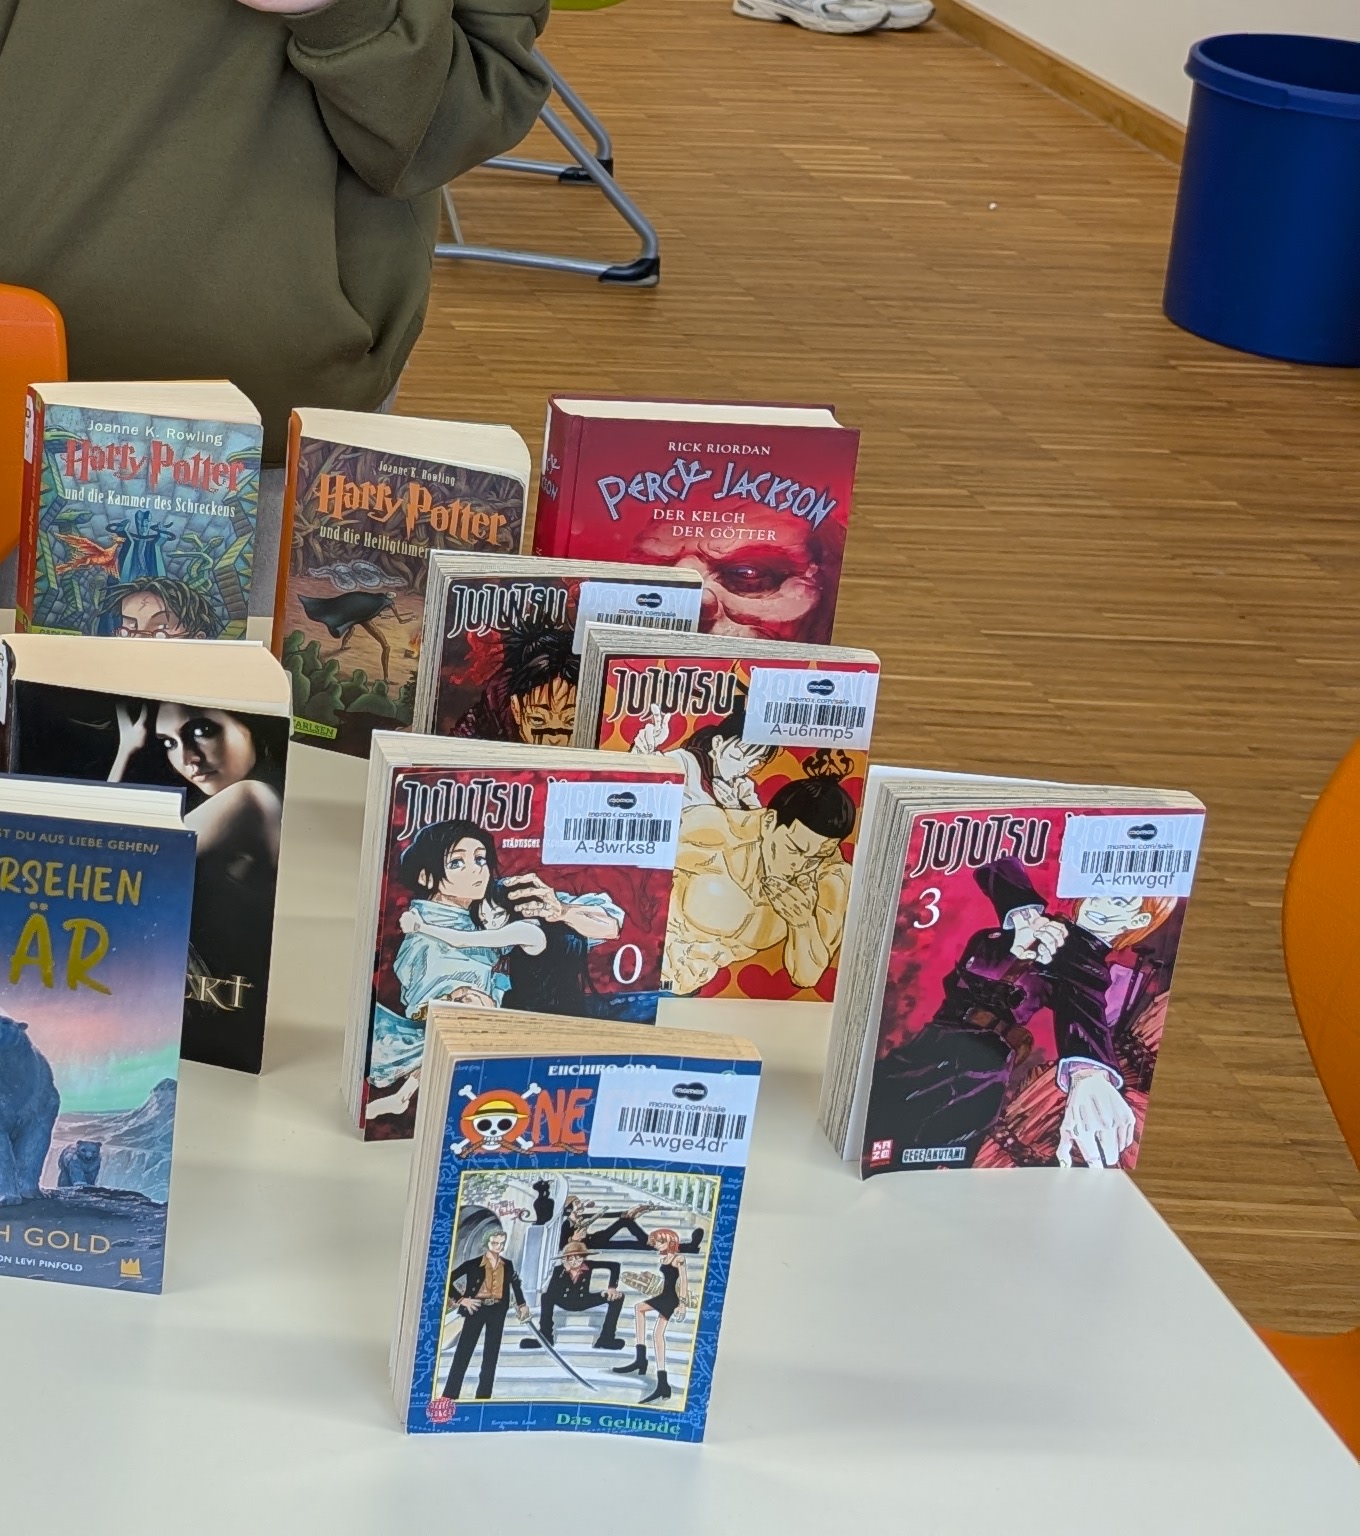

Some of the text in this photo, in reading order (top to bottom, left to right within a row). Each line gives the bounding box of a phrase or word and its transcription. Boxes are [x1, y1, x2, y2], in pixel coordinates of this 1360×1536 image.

[87, 420, 223, 447] Joanne K. Rowling
[668, 442, 771, 455] RICK RIORDAN
[60, 438, 246, 493] Harry Potter
[64, 488, 236, 518] und die Kammer des Schreckens
[597, 458, 836, 530] PERCY JACKSON
[315, 473, 508, 546] Harry Potter
[653, 508, 745, 524] DER KELCH
[319, 525, 429, 560] und die Heiligtümer
[672, 526, 777, 541] DER GÖTTER
[607, 667, 737, 722] JUJUTSU
[770, 723, 854, 740] A-u6nmp5
[397, 778, 533, 841] JUJUTSU
[15, 829, 36, 841] DU
[38, 832, 65, 845] AUS
[69, 835, 103, 848] LIEBE
[574, 840, 656, 855] A-8wrks8
[910, 813, 1052, 878] JUJUTSU
[1091, 872, 1175, 889] A-knwgqf
[913, 887, 942, 929] 3
[612, 944, 643, 984] 0
[629, 1132, 729, 1153] A-wge4dr
[23, 1227, 112, 1255] GOLD
[15, 1257, 37, 1266] LEVI
[39, 1260, 83, 1272] PINFOLD
[556, 1413, 680, 1436] Das Gelübde
